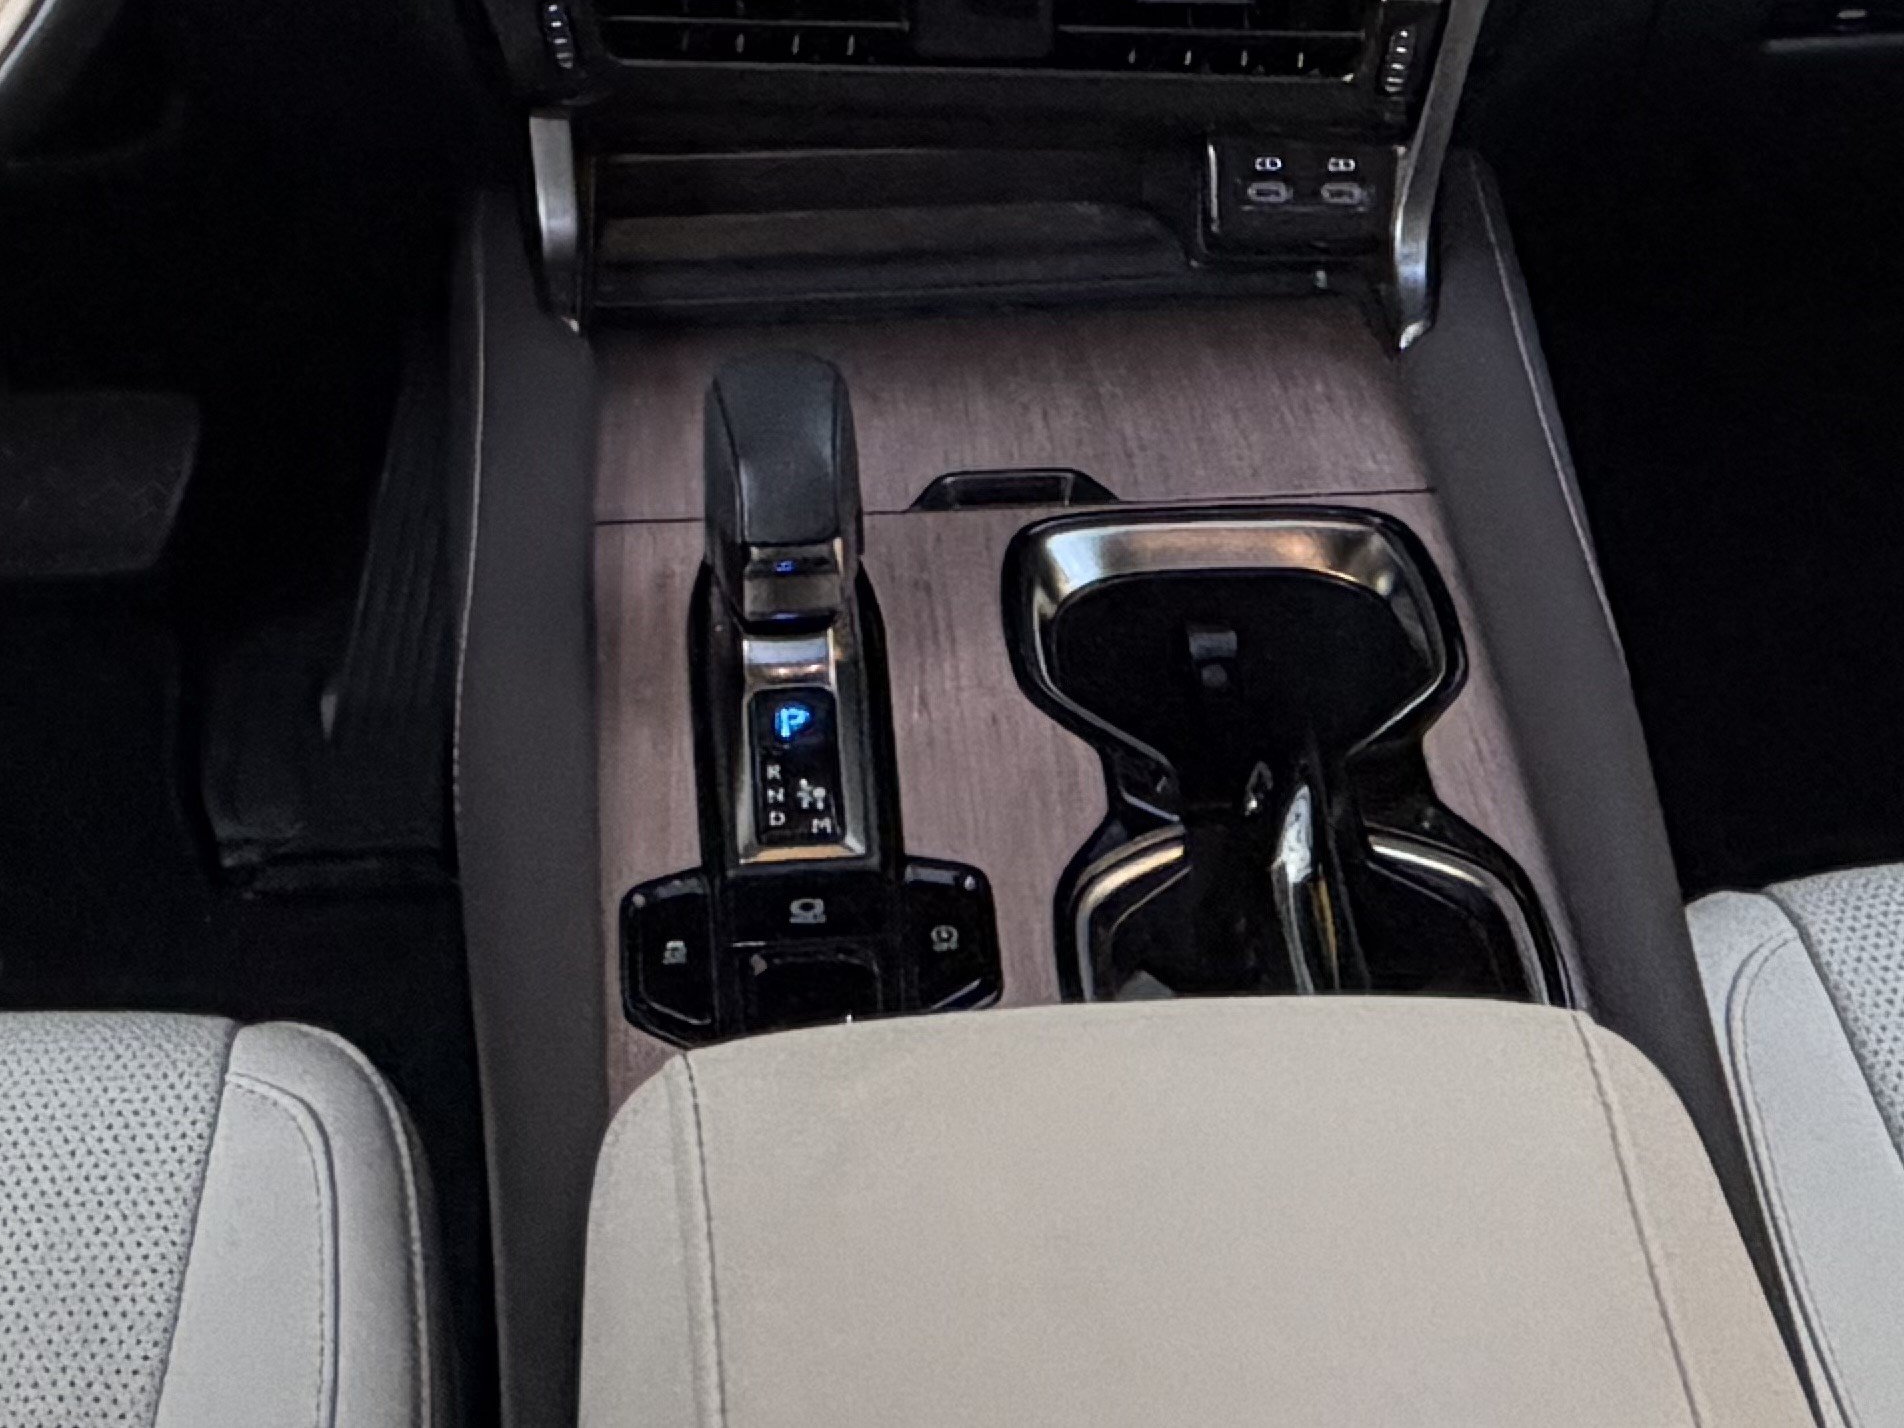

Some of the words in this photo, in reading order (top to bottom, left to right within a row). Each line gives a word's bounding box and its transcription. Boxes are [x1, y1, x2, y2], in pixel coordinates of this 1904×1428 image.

[778, 706, 810, 738] P
[766, 764, 782, 780] R
[766, 788, 785, 804] N
[768, 810, 786, 827] D
[811, 816, 833, 835] M
